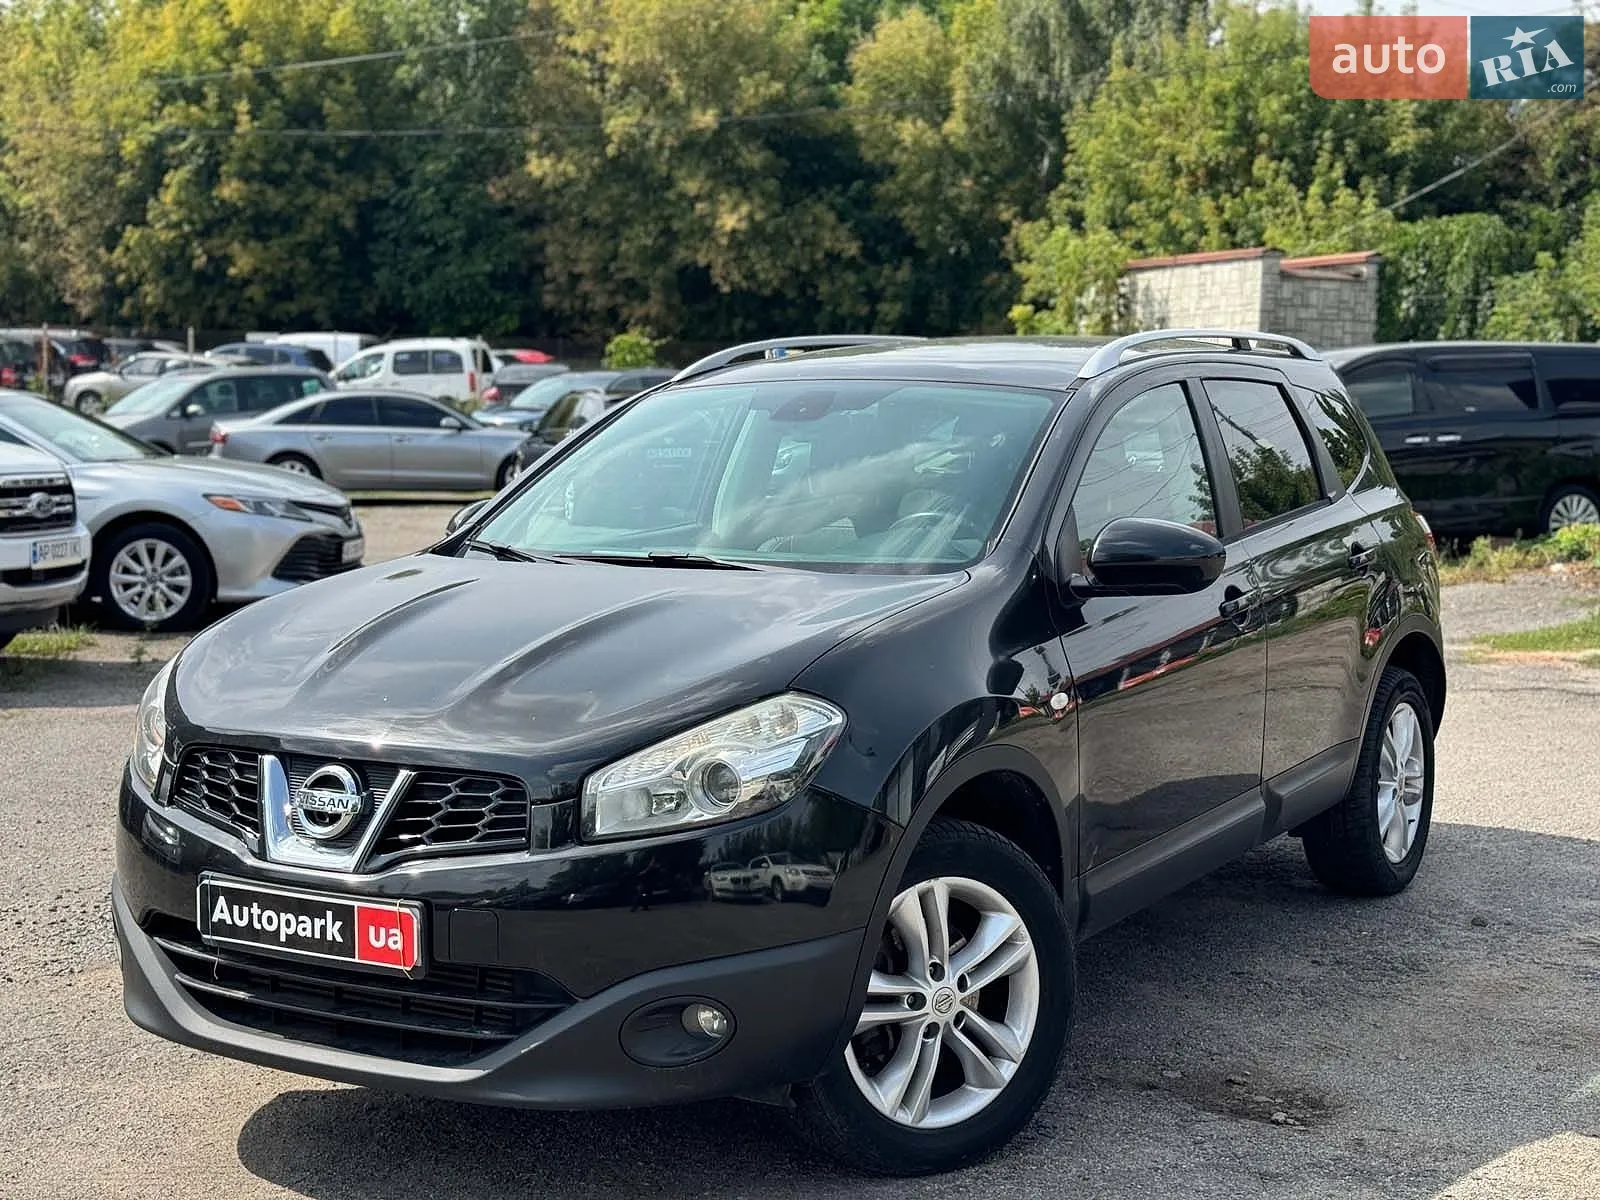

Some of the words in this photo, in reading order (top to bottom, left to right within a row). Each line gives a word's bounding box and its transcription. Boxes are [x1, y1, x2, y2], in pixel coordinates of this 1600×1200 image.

[297, 790, 350, 809] NISSAN
[211, 895, 344, 942] Autopark
[368, 925, 403, 951] ua
